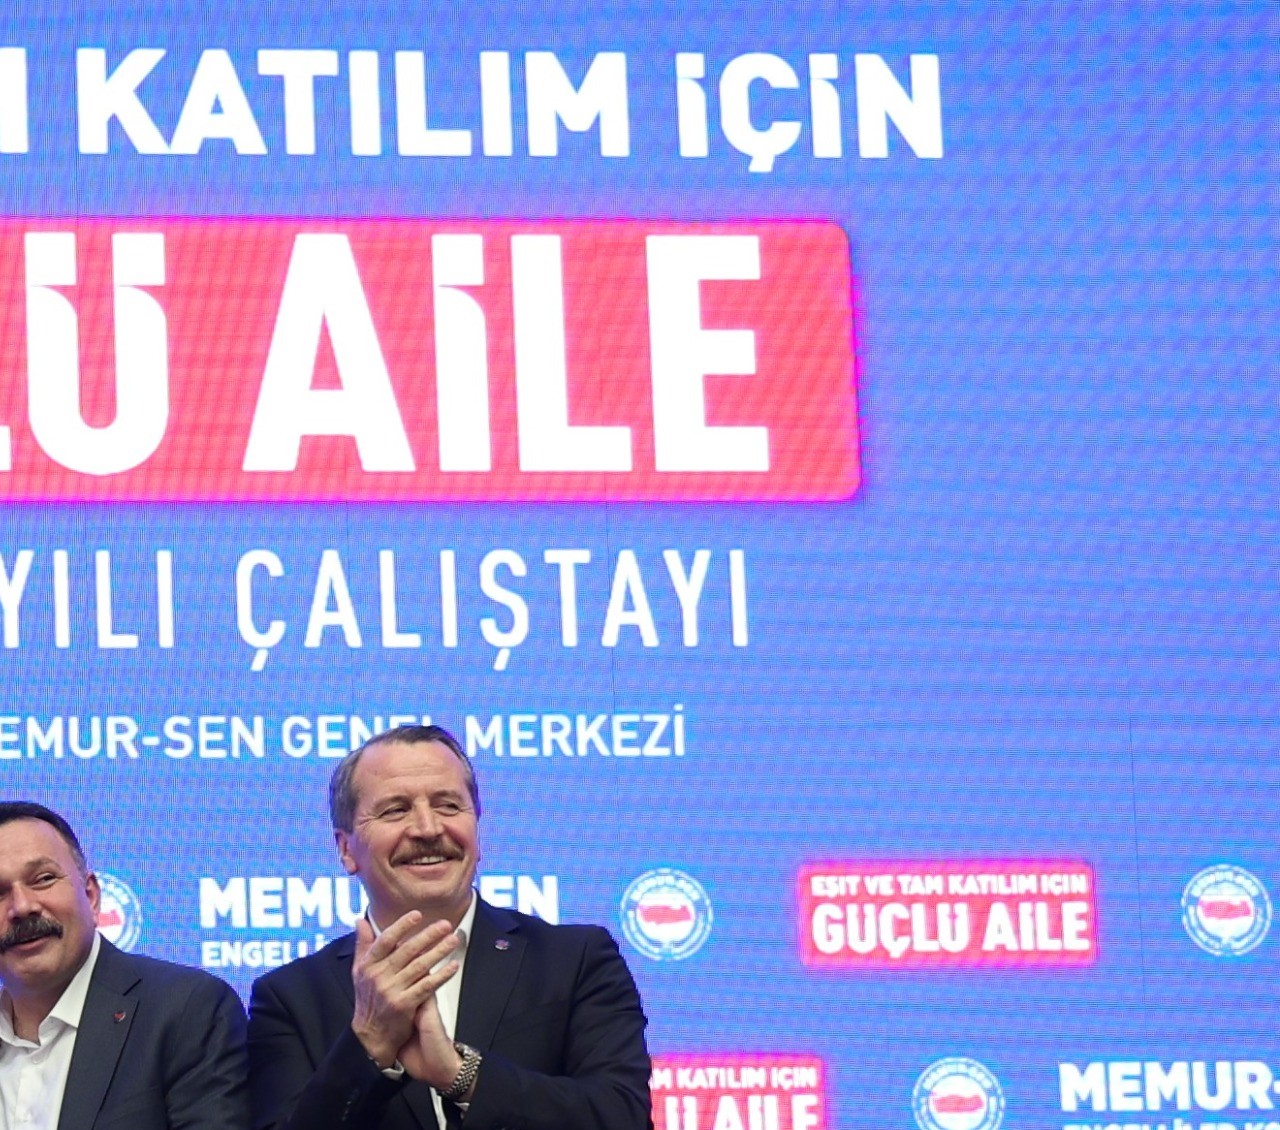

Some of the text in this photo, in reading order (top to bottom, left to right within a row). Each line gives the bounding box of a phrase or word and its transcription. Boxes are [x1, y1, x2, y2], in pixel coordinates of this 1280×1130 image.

[77, 49, 629, 157] KATILIM
[676, 53, 943, 172] İÇİN
[242, 233, 770, 472] AİLE
[236, 549, 748, 671] ÇALIŞTAYI
[283, 716, 431, 757] GEN
[465, 704, 685, 757] MERKEZİ
[864, 875, 894, 896] VE
[897, 875, 944, 895] TAM
[948, 874, 1038, 895] KATILIM
[677, 1067, 766, 1089] KATILIM
[1059, 1061, 1280, 1111] MEMUR
